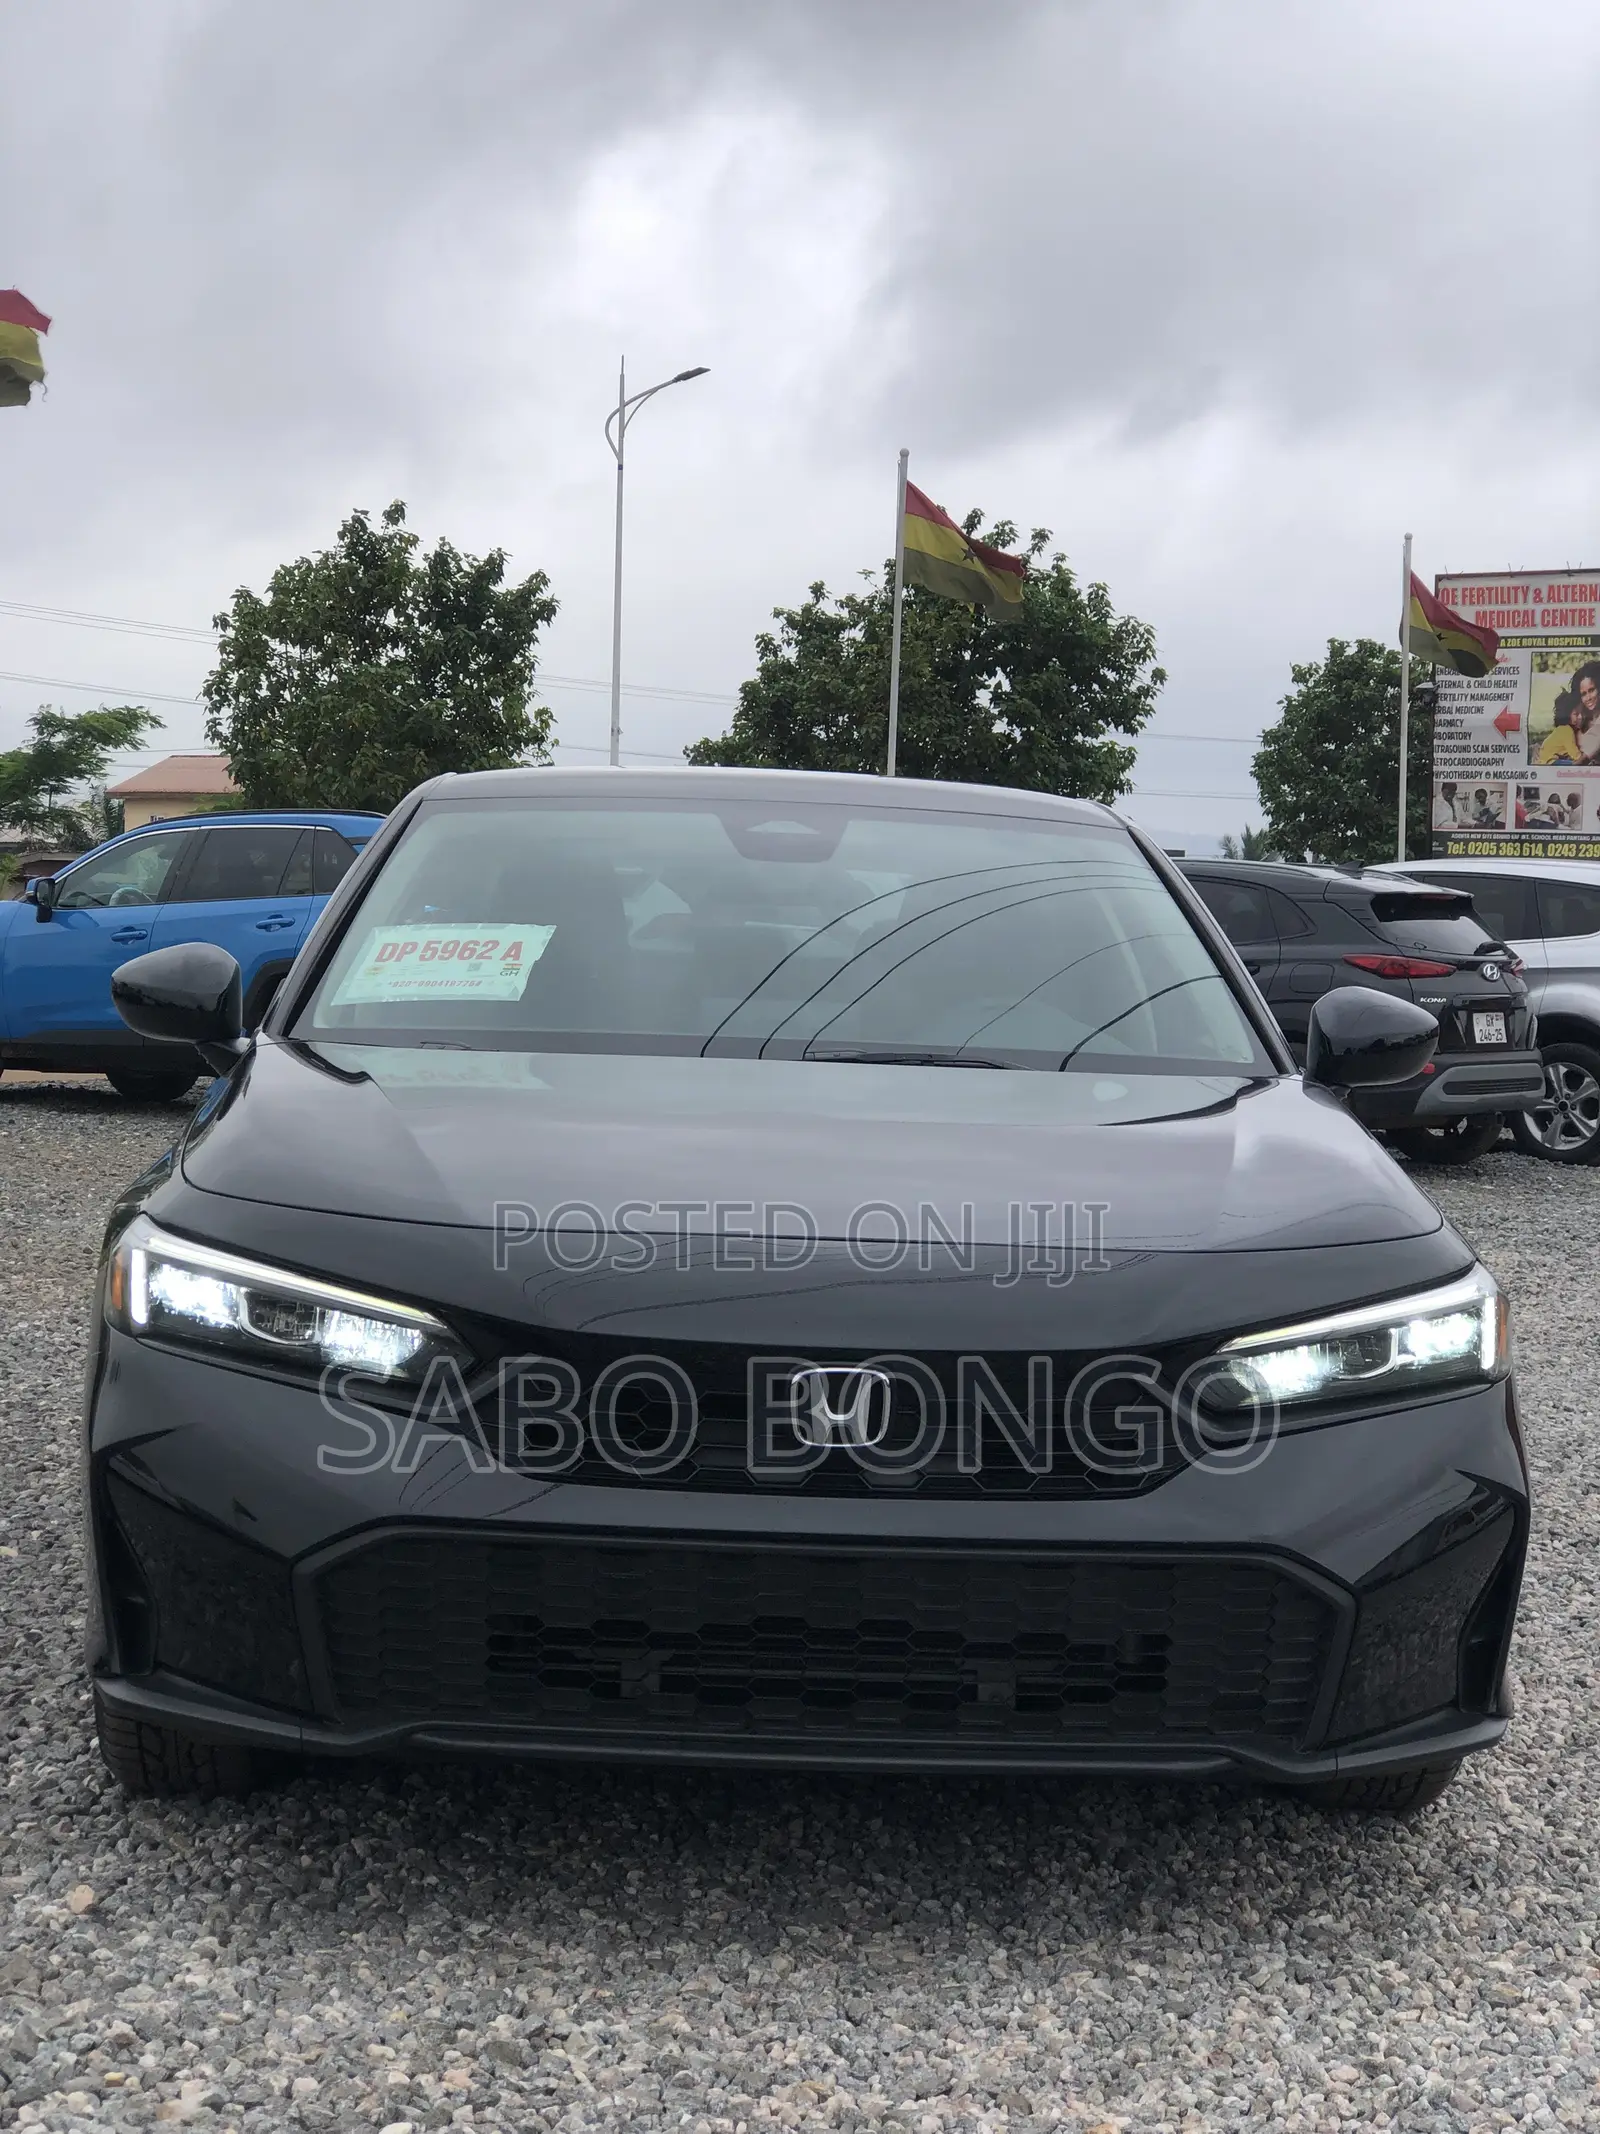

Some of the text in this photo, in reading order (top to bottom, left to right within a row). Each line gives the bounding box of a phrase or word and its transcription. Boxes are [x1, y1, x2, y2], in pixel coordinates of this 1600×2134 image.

[1438, 583, 1600, 606] OE FERTILITY & ALTERN
[1475, 608, 1596, 629] MEDICAL CENTRE
[1500, 638, 1507, 648] A
[1507, 637, 1521, 647] ZOE
[1522, 637, 1546, 647] ROYAL
[1547, 637, 1587, 647] HOSPITAL
[1437, 680, 1518, 689] ATERNAL & CHILD HEALTH
[1469, 693, 1514, 702] MANAGEMENT
[1435, 706, 1485, 715] ERBAL MEDICINE
[1435, 719, 1464, 728] HARMACY
[1433, 732, 1472, 741] ABORATORY
[1473, 745, 1490, 753] SCAN
[1491, 745, 1521, 754] SERVICES
[1493, 771, 1529, 780] MASSAGING
[1447, 842, 1465, 855] Tel:
[1468, 842, 1497, 855] 0205
[1499, 842, 1520, 856] 363
[1523, 843, 1545, 858] 614,
[1547, 843, 1576, 857] 0243
[375, 940, 524, 963] DP 5962 A
